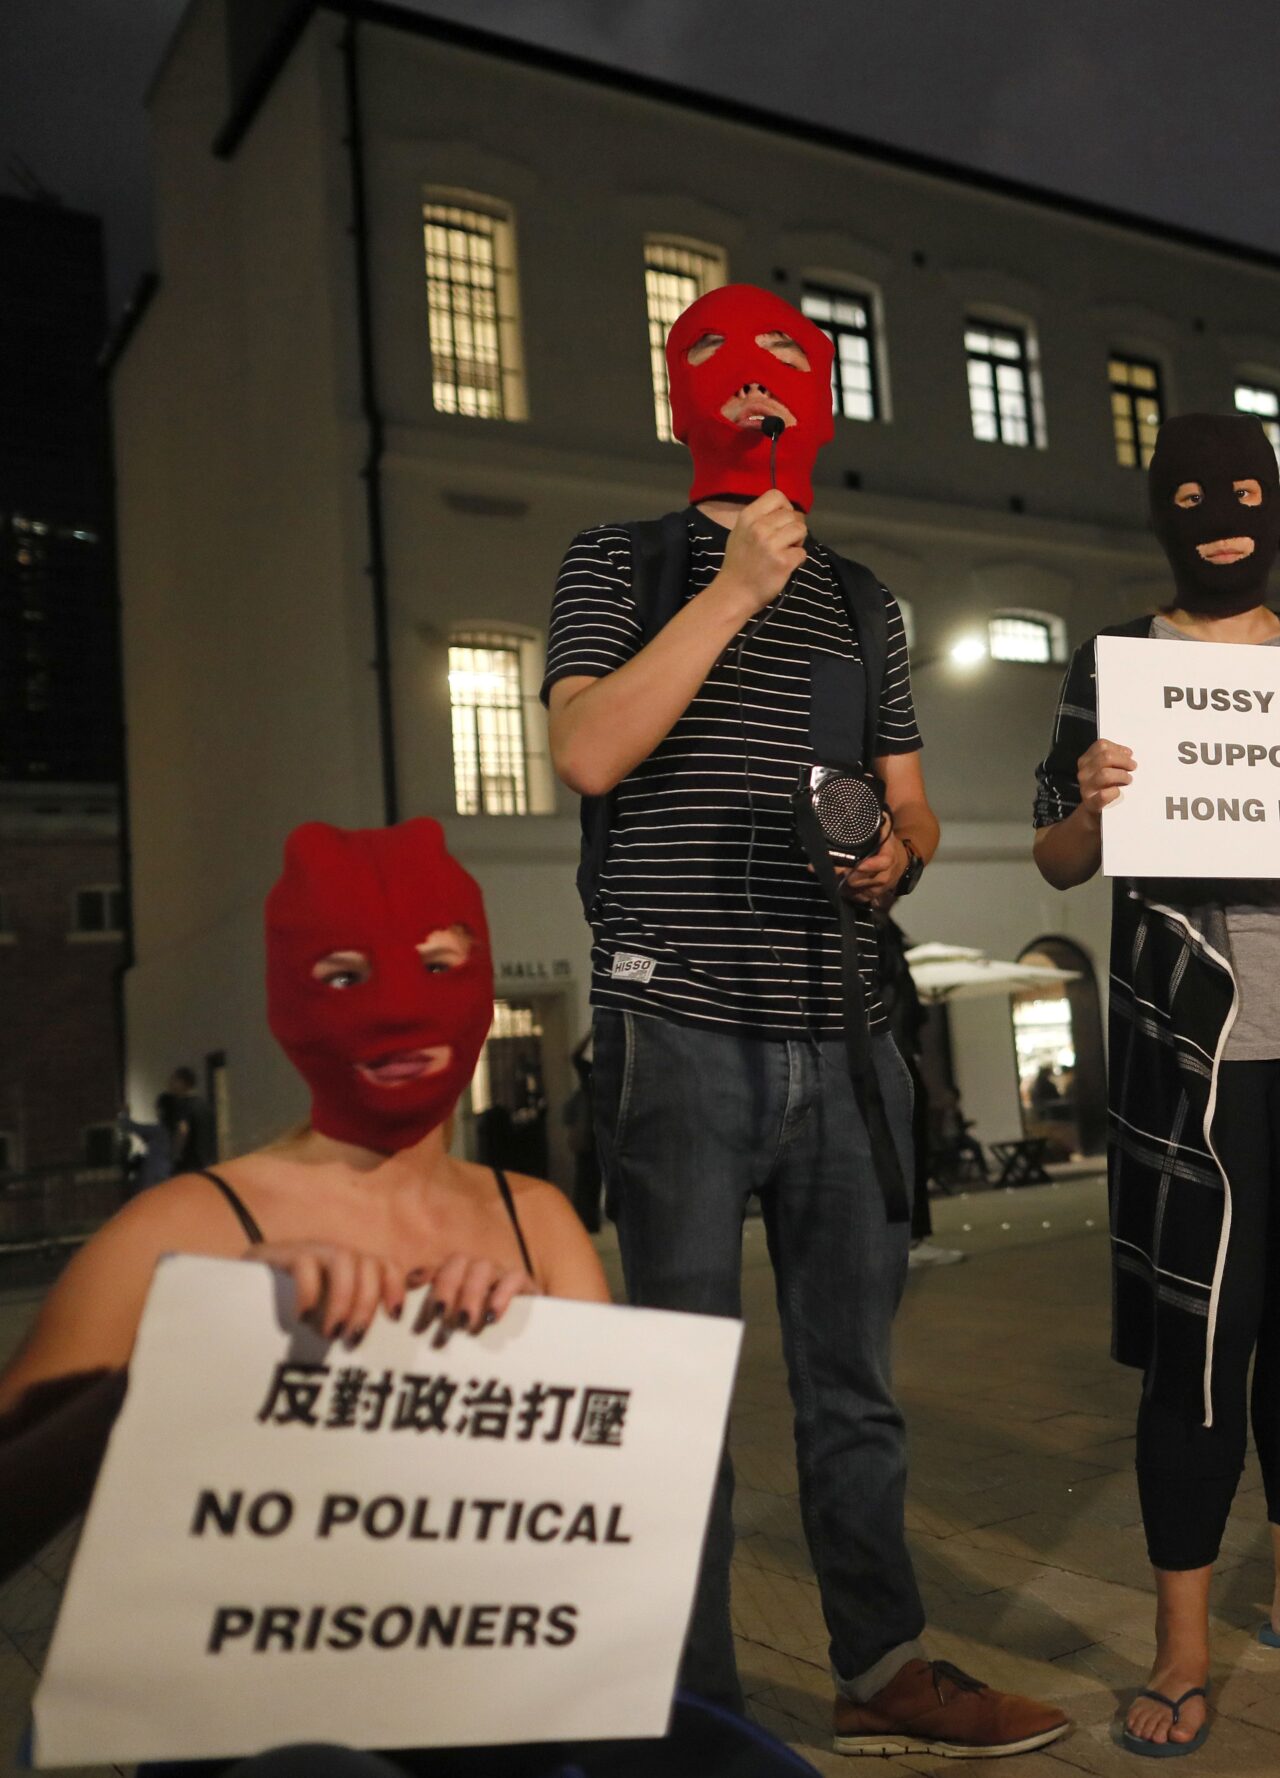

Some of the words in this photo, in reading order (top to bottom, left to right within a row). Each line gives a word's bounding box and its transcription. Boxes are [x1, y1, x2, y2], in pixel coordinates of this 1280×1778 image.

[1163, 686, 1275, 713] PUSSY
[1165, 796, 1266, 822] HONG
[615, 960, 651, 973] HISSO
[257, 1362, 632, 1447] 反對政治打壓
[190, 1489, 295, 1538] NO
[316, 1493, 633, 1545] POLITICAL
[205, 1602, 581, 1656] PRISONERS
